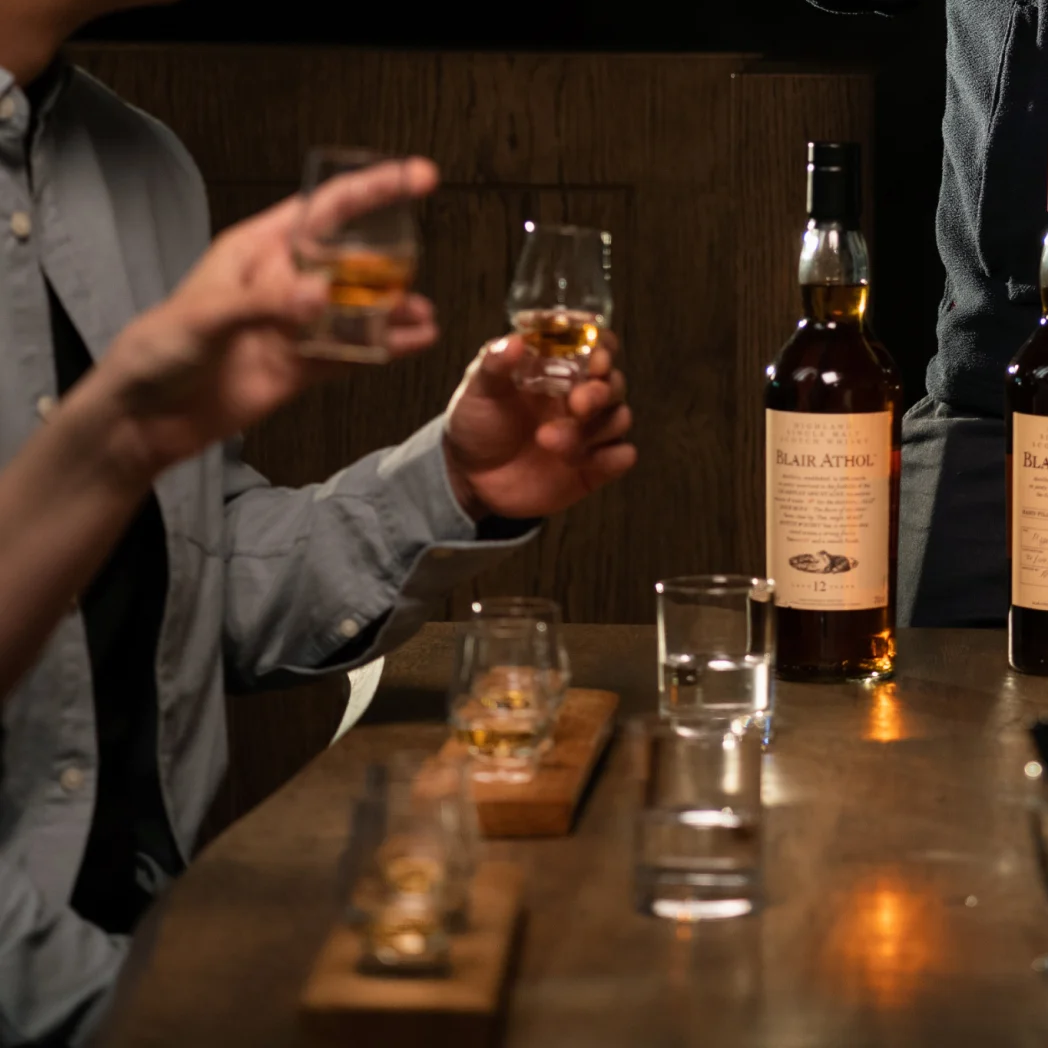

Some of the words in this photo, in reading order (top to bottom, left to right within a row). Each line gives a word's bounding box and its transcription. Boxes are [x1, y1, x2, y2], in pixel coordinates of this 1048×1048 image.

[776, 448, 816, 467] BLAIR
[820, 453, 874, 468] ATHOL
[813, 580, 827, 592] 12
